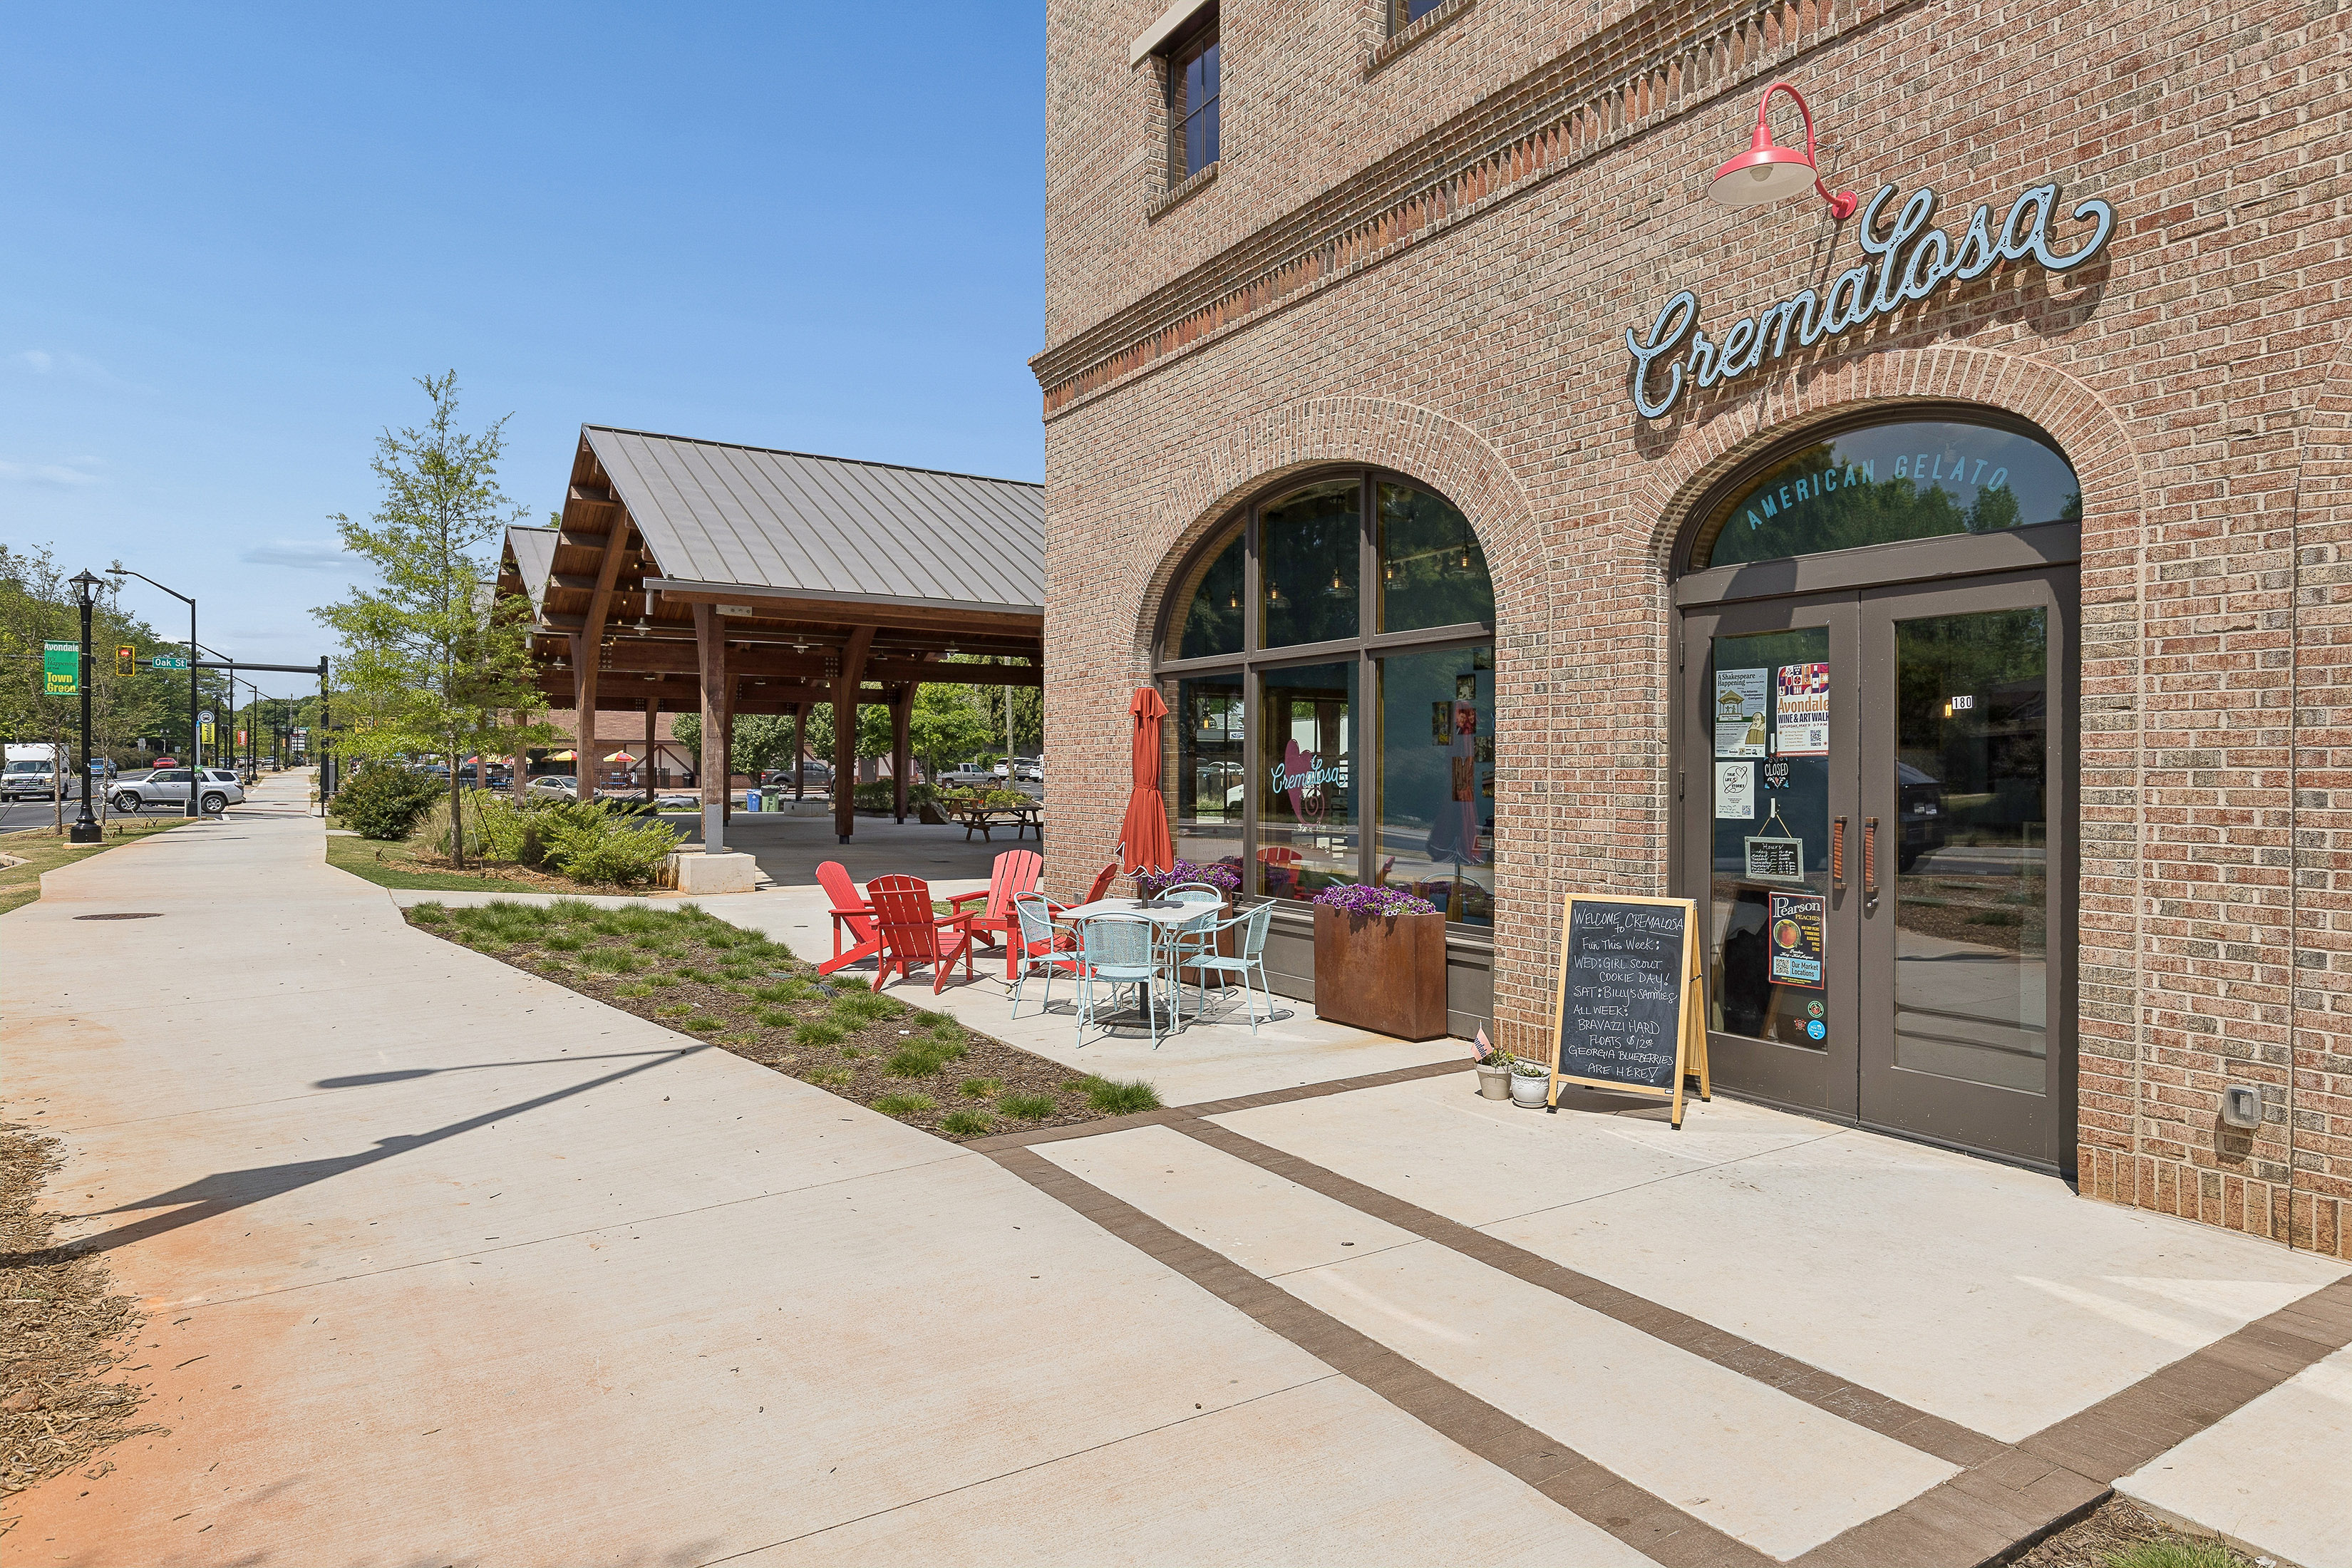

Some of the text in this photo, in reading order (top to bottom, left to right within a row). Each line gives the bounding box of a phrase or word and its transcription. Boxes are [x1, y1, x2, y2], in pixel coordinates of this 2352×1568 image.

[1746, 454, 2008, 530] AMERICAN GELATO
[44, 642, 79, 651] Avondale
[46, 672, 73, 683] Town
[47, 683, 76, 692] Green
[1778, 696, 1830, 713] Avondale
[1954, 697, 1971, 708] 180
[1778, 713, 1793, 723] WINE
[1794, 713, 1799, 723] &
[1800, 713, 1811, 722] ART
[1765, 763, 1789, 776] CLOSED
[1773, 897, 1821, 917] Pearson
[1574, 908, 1683, 933] WELCOME to CREMALOSA
[1582, 937, 1599, 950] Fun
[1601, 939, 1622, 950] This
[1604, 957, 1625, 970] GIRL
[1630, 959, 1663, 969] SCOUT
[1802, 962, 1818, 971] Market
[1792, 968, 1815, 977] Locations
[1599, 971, 1670, 991] COOKIE DAY!
[1574, 1004, 1629, 1017] ALL WEEK:
[1578, 1018, 1660, 1035] BRAVAZZI HARD
[1589, 1035, 1621, 1049] FLOATS
[1569, 1045, 1673, 1066] GEORGIA BLUEBERRIES
[1588, 1063, 1659, 1083] ARE HERE!
